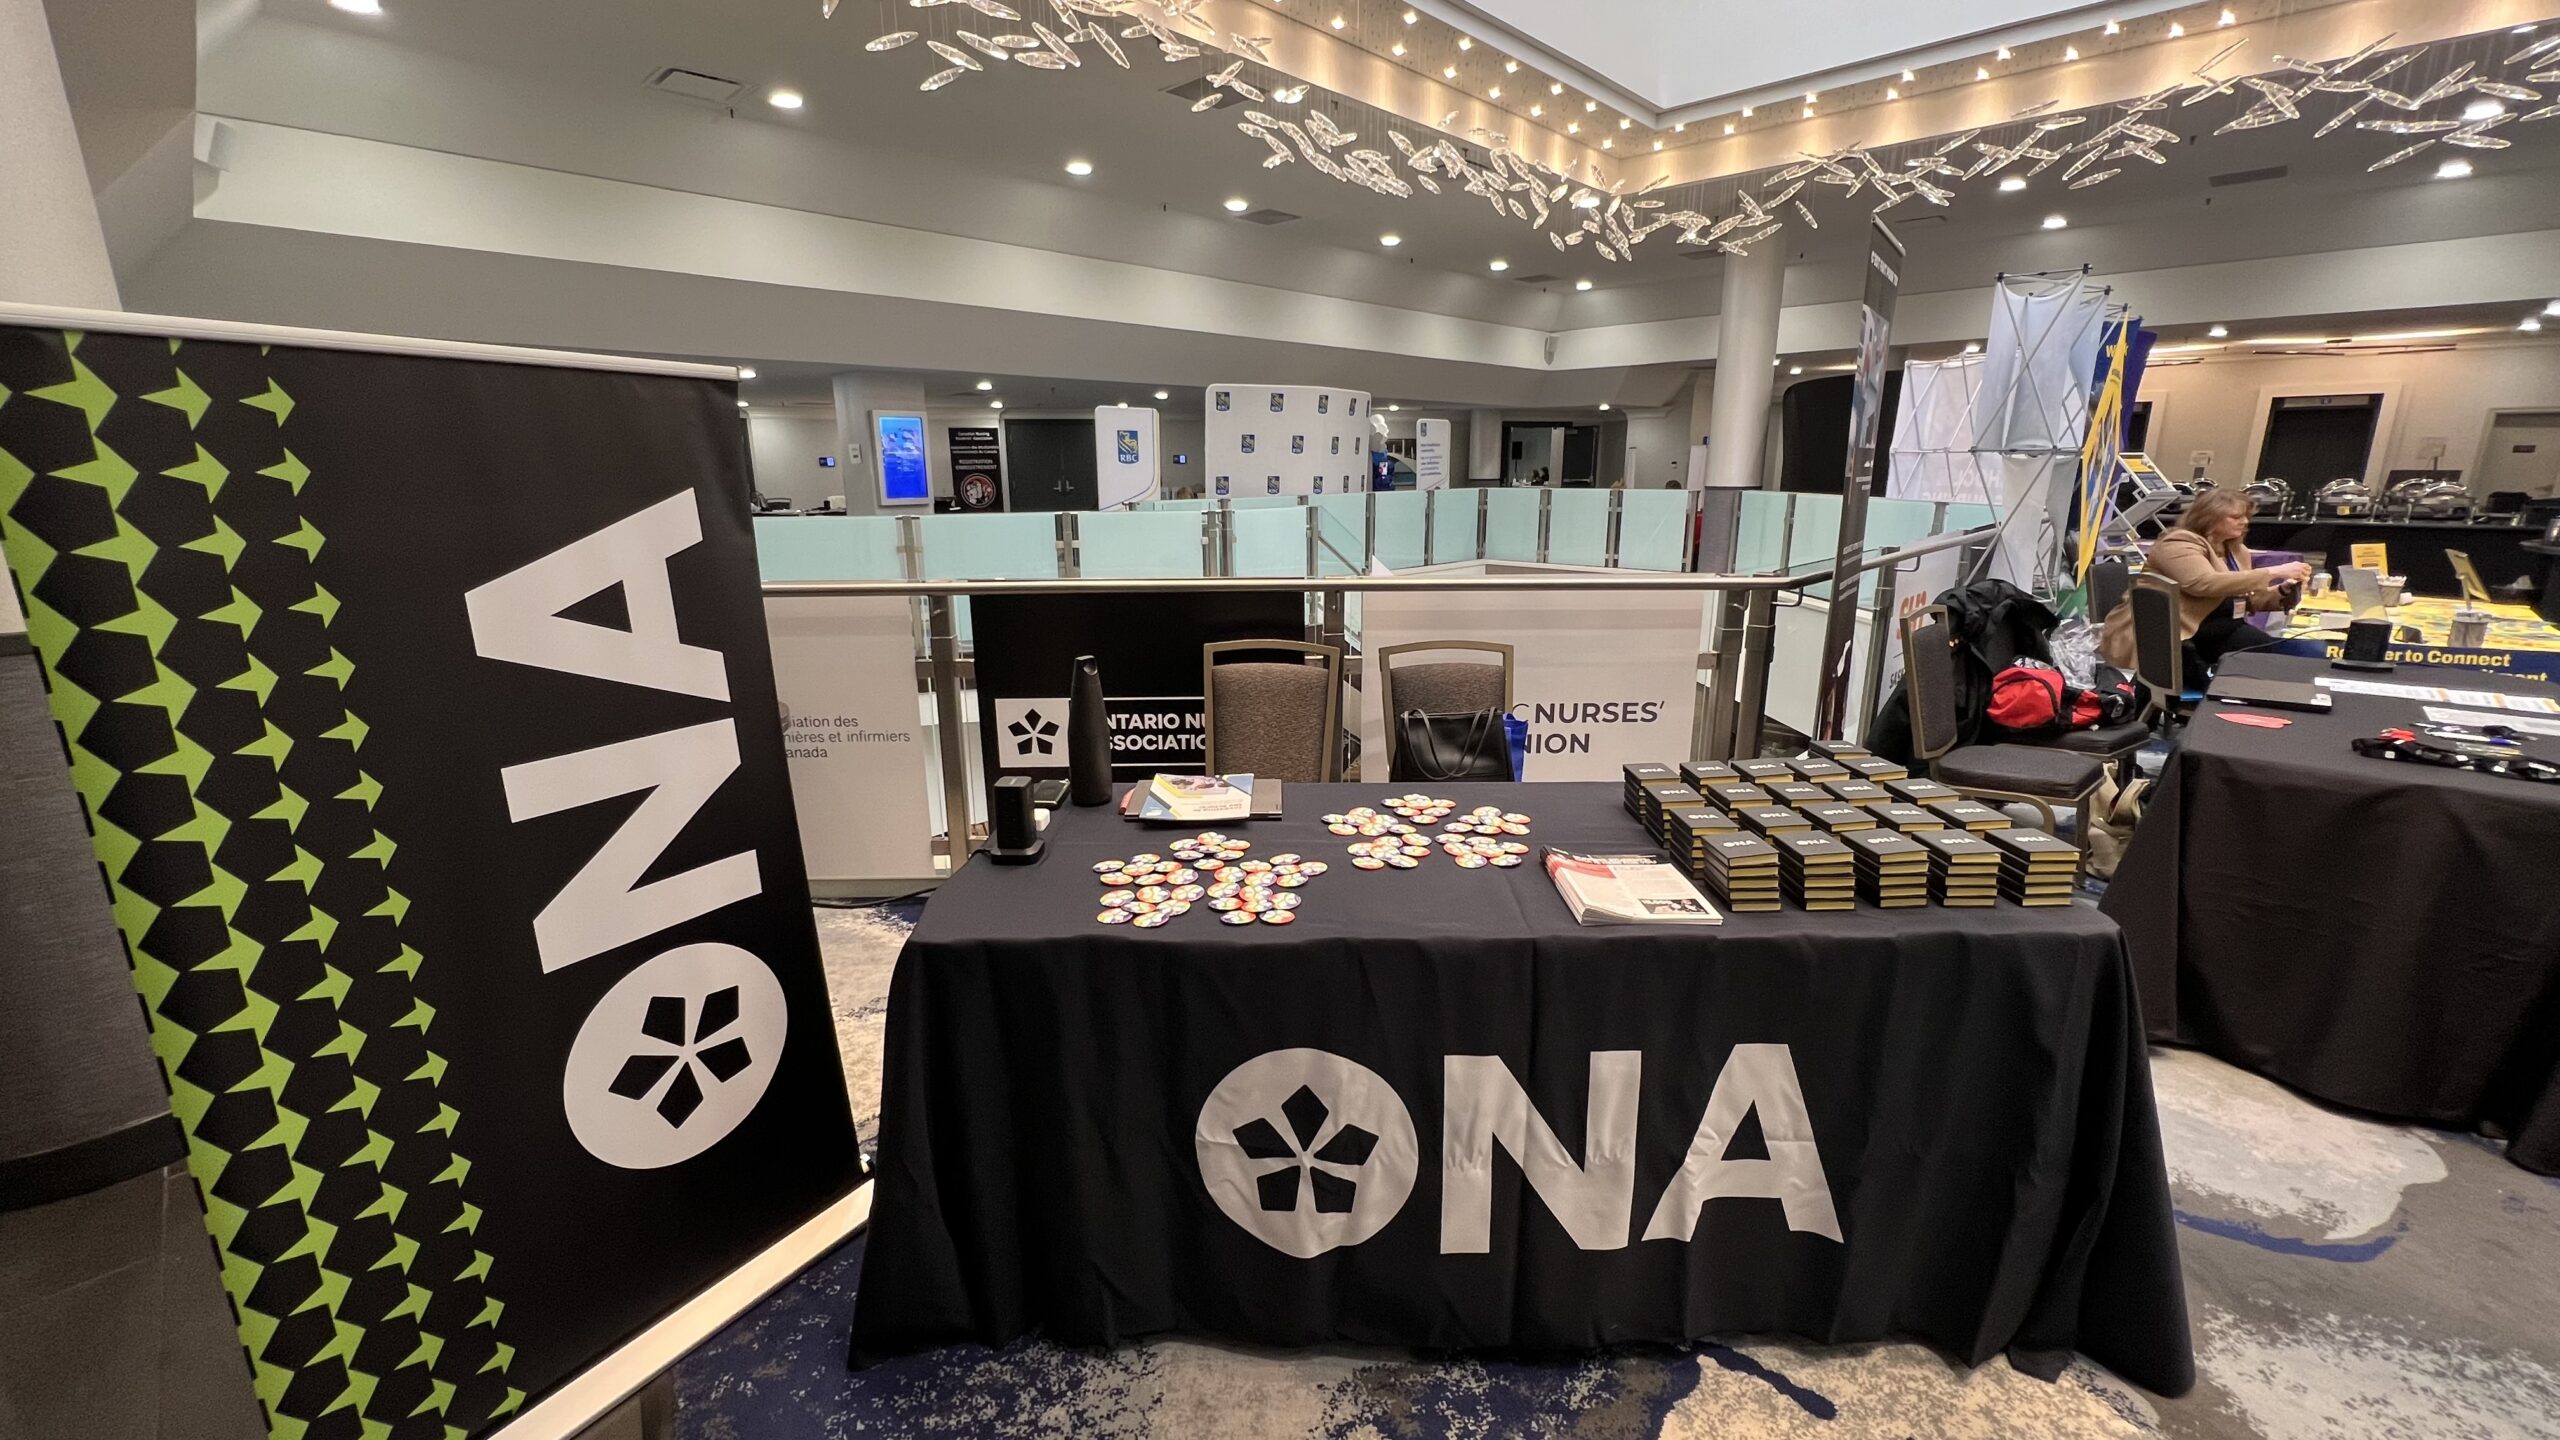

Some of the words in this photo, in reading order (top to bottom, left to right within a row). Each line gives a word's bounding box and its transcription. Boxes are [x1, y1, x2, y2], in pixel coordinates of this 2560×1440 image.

[1119, 454, 1138, 463] RBC
[2406, 649, 2423, 663] to
[2427, 650, 2512, 667] Connect
[1535, 701, 1665, 724] NURSES'
[792, 716, 830, 728] iation
[834, 716, 859, 727] des
[1106, 713, 1180, 729] NTARIO
[829, 732, 842, 743] et
[847, 730, 911, 742] infirmiers
[1109, 734, 1206, 751] SOCIATIO
[786, 746, 828, 759] anada
[465, 488, 788, 1169] ONA
[1195, 1043, 1844, 1258] ONA
